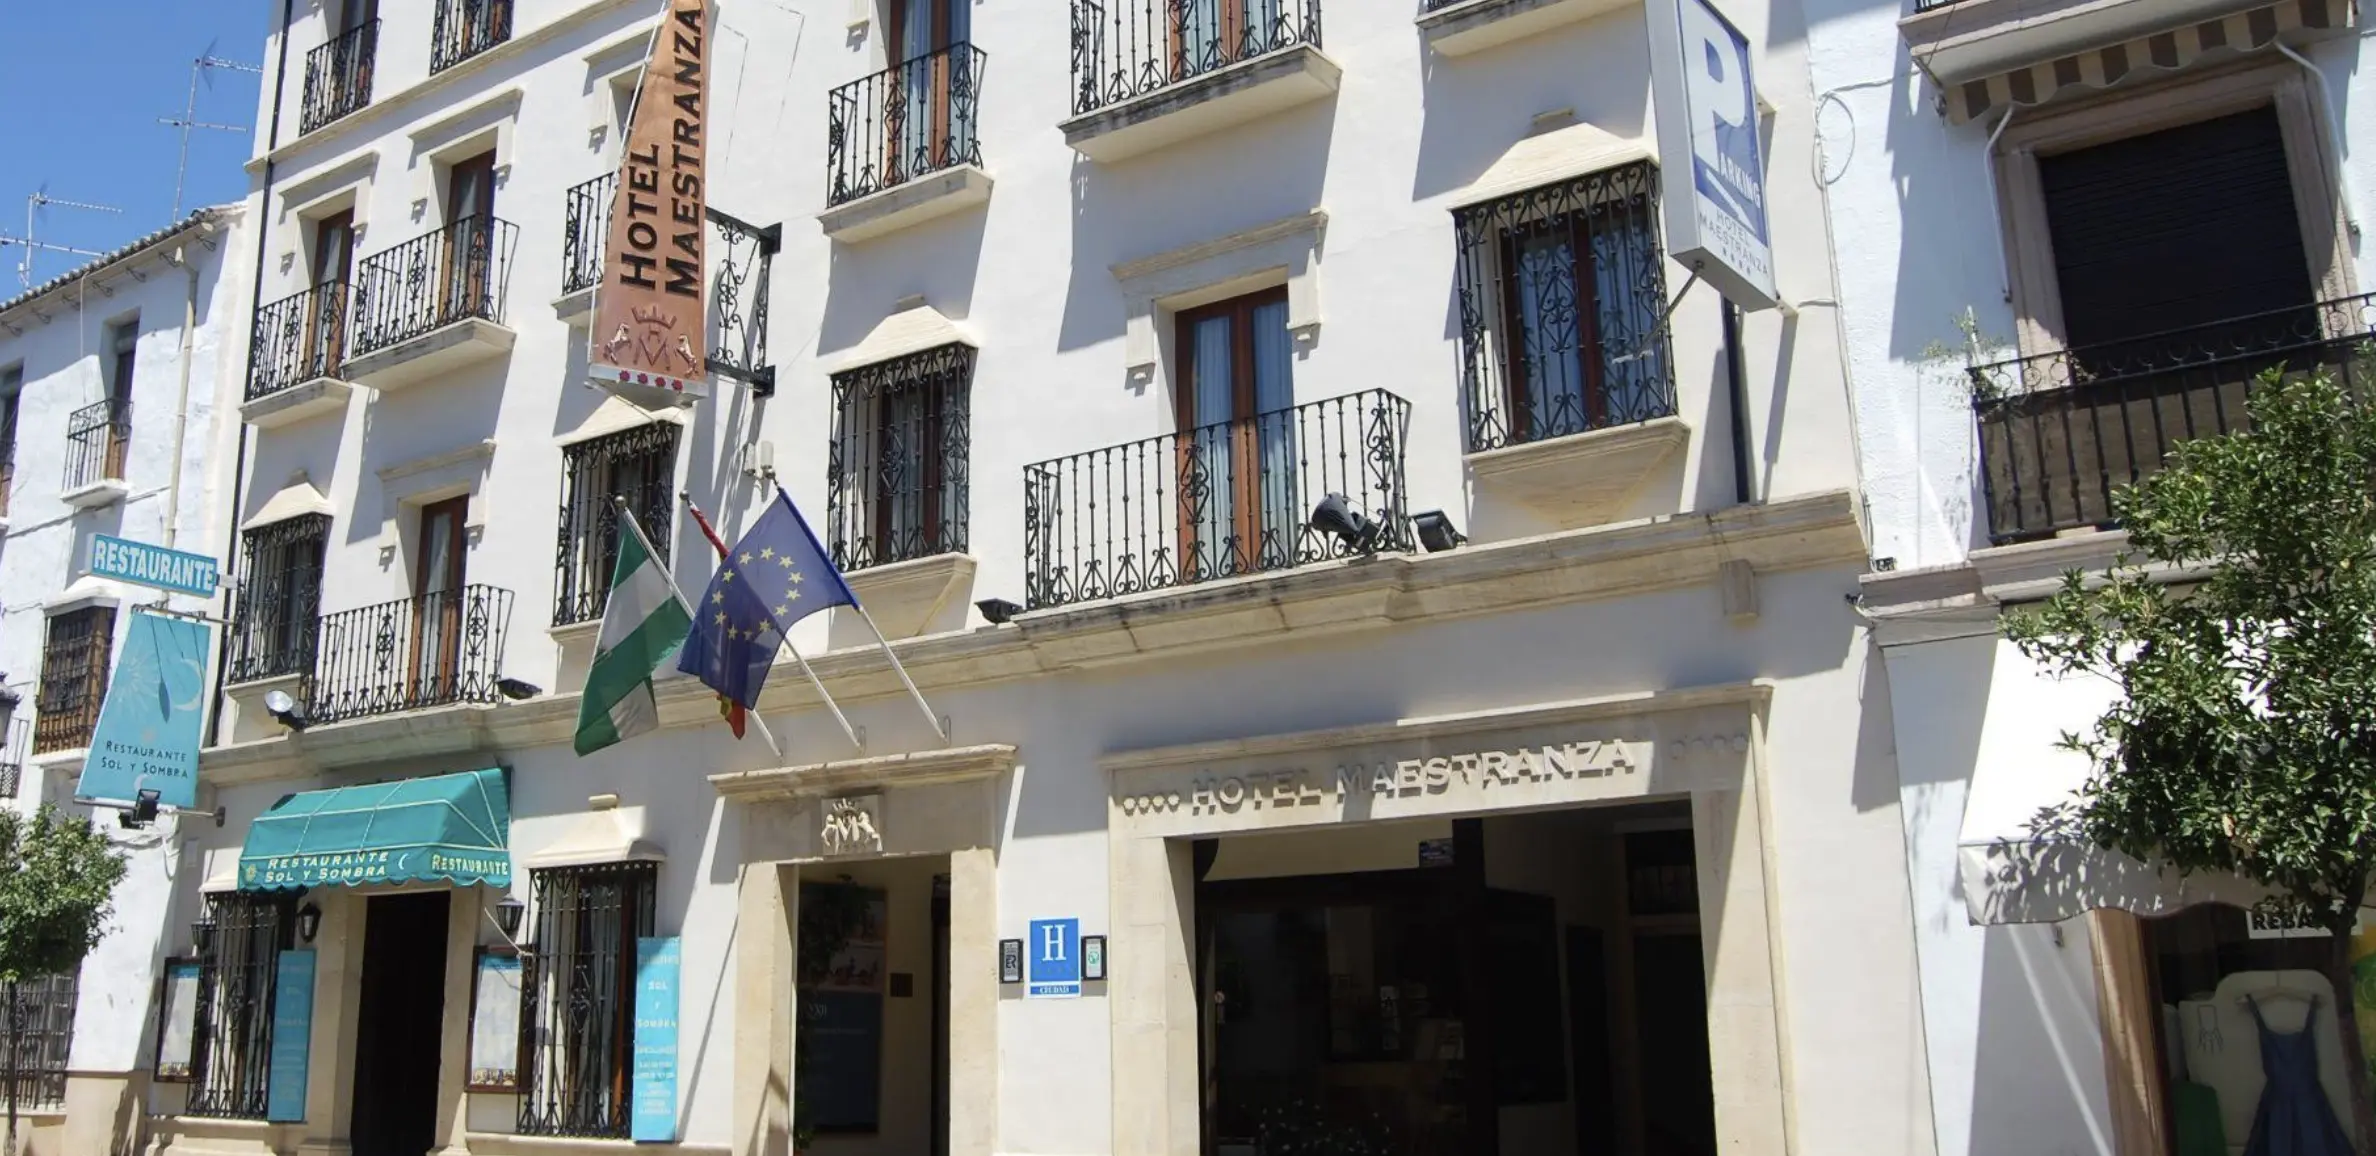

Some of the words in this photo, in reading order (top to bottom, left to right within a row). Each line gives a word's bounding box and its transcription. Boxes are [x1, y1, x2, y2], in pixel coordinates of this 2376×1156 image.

[665, 7, 703, 299] MAESTRANZA
[620, 143, 660, 290] HOTEL
[1716, 208, 1751, 247] HOTEL
[1699, 211, 1768, 275] MAESTRANZA
[94, 539, 215, 591] RESTAURANTE
[106, 741, 187, 762] RESTAURANTE
[143, 762, 188, 779] SOMBRA
[1192, 769, 1322, 808] HOTEL
[1336, 739, 1635, 794] MAESTRANZA
[264, 870, 294, 883] SOL
[319, 866, 386, 880] SOMBRA
[268, 851, 389, 869] RESTAURANTE
[431, 854, 509, 876] RESTAURANTE
[1041, 924, 1067, 962] H
